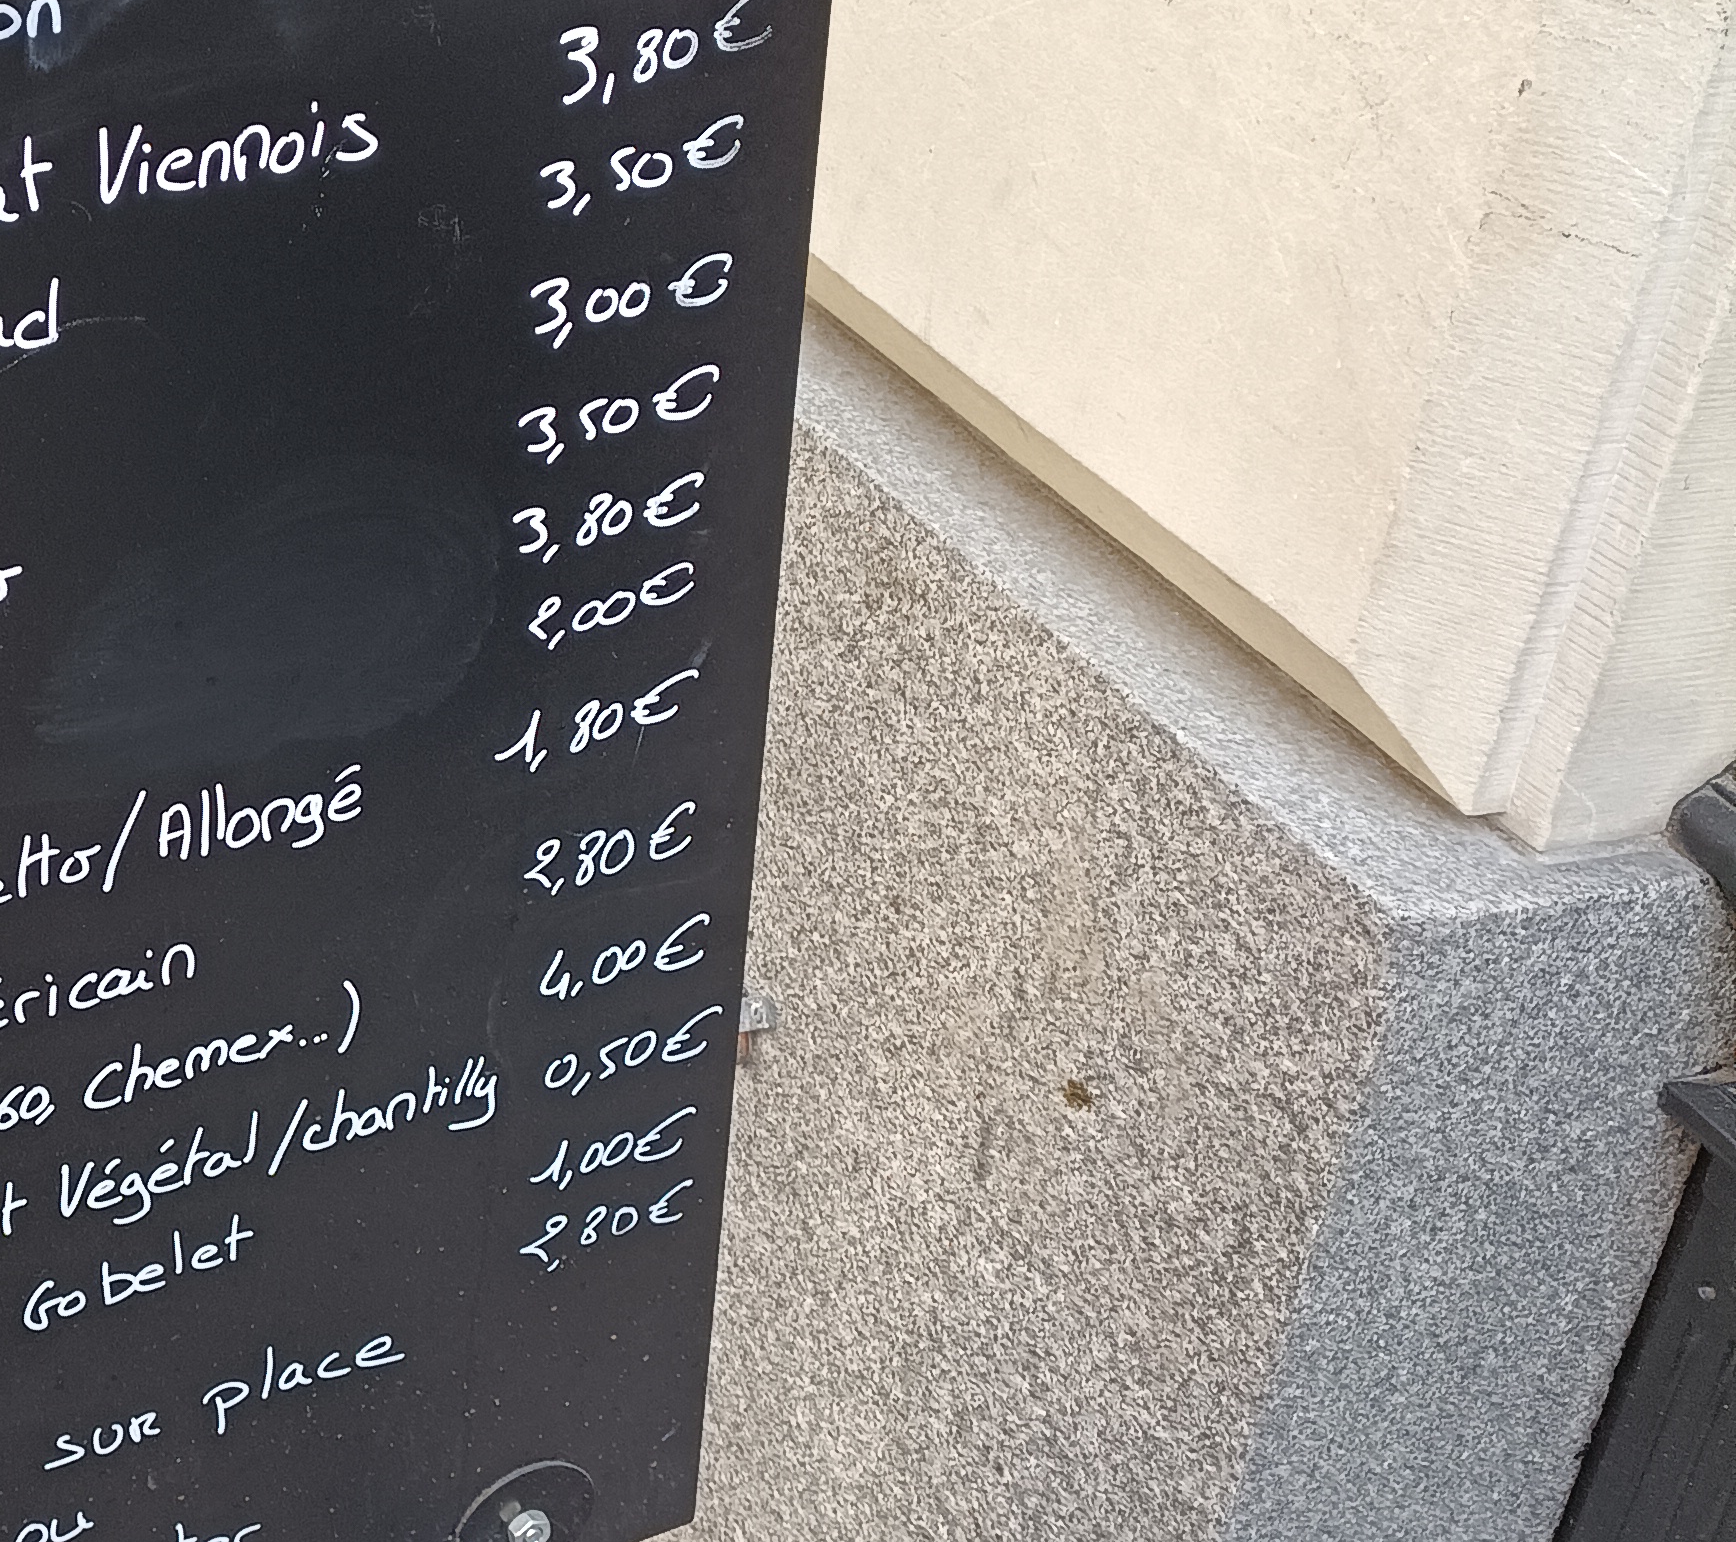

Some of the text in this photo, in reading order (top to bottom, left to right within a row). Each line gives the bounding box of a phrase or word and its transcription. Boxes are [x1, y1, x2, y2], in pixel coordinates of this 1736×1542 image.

[97, 99, 380, 206] Viennois
[22, 1213, 255, 1332] Gobelet
[201, 1334, 406, 1436] place
